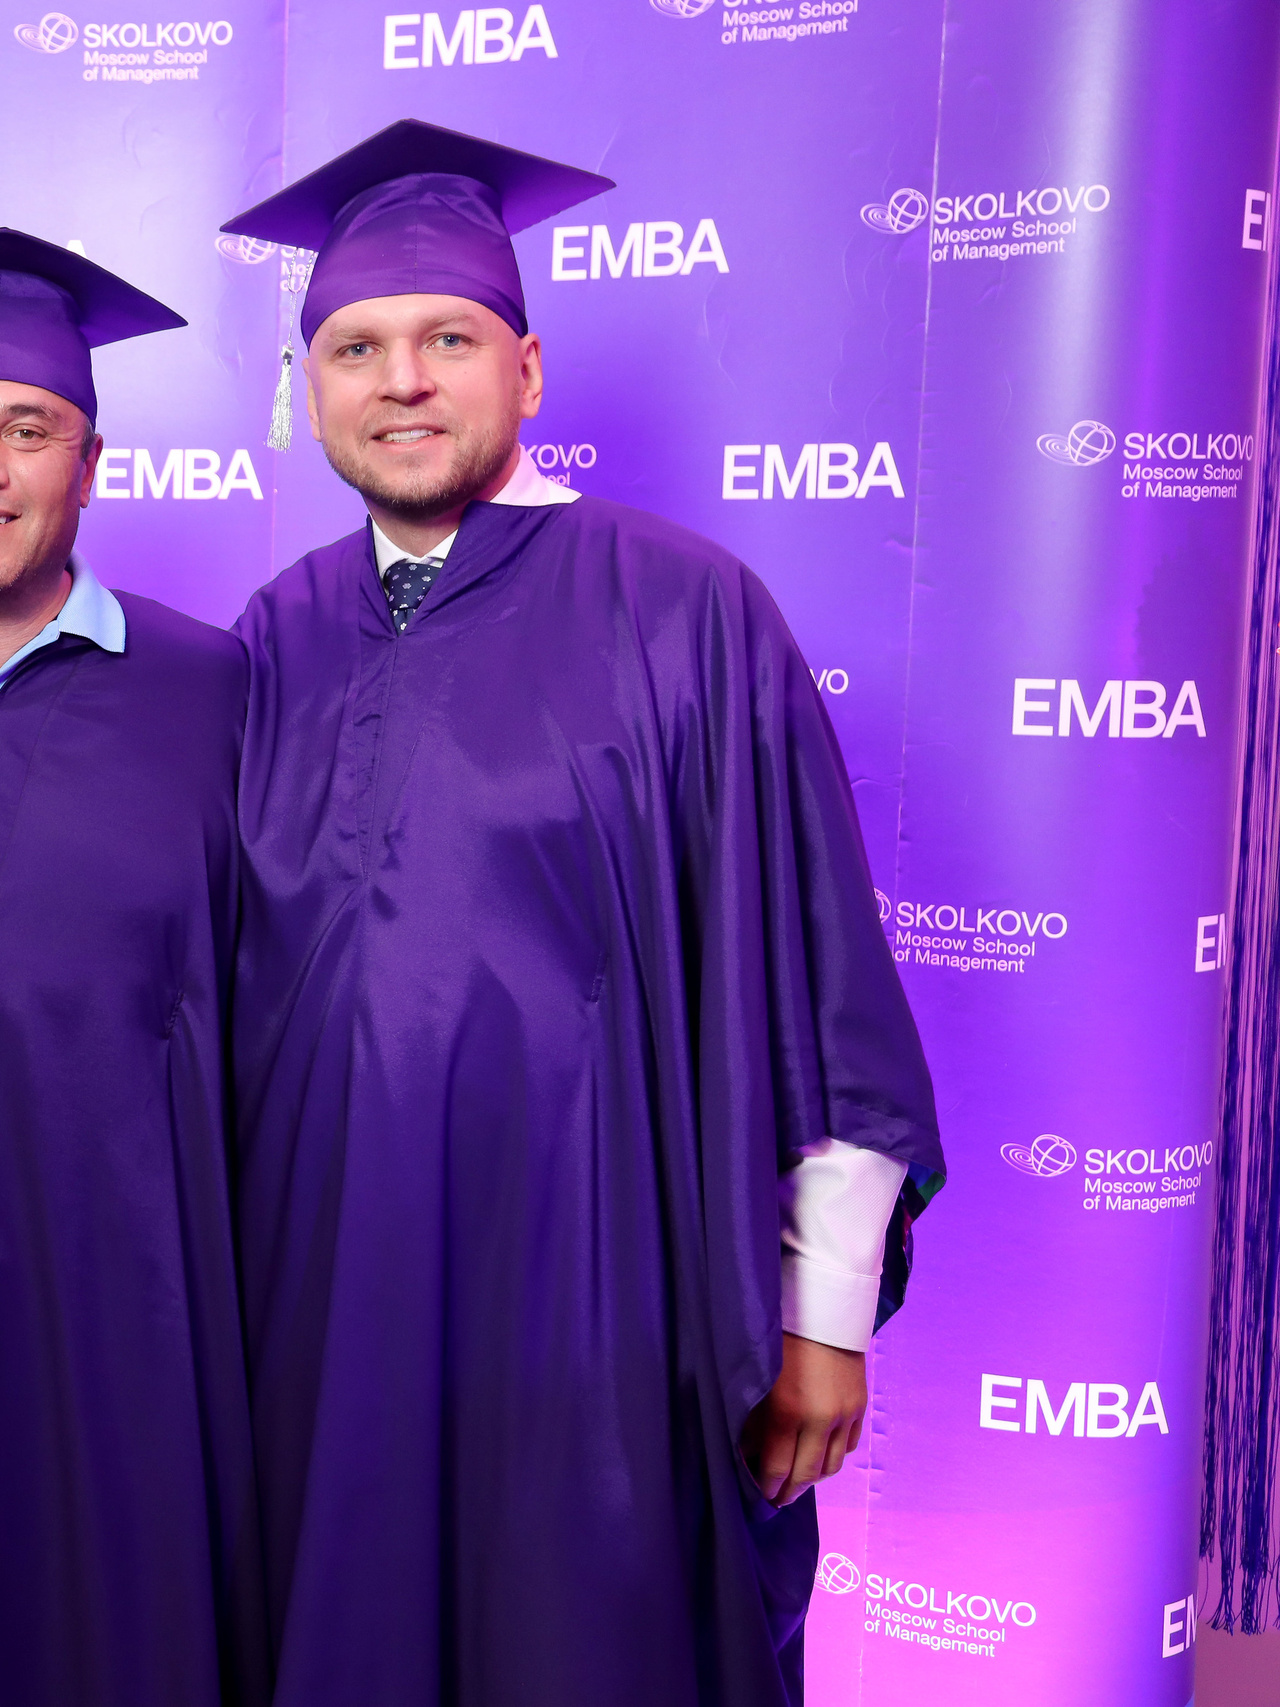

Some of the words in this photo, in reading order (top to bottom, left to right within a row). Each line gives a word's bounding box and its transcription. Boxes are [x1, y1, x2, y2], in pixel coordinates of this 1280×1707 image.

[723, 9, 794, 27] Moscow
[799, 0, 859, 19] School
[84, 21, 233, 47] SKOLKOVO
[384, 5, 558, 69] EMBA
[721, 27, 738, 44] of
[742, 16, 848, 42] Management
[84, 51, 149, 65] Moscow
[154, 49, 207, 64] School
[83, 67, 98, 81] of
[102, 66, 199, 84] Management
[933, 185, 1110, 224] SKOLKOVO
[933, 226, 1006, 245] Moscow
[1012, 218, 1076, 238] School
[551, 218, 730, 281] EMBA
[932, 243, 948, 262] of
[953, 238, 1064, 261] Management
[1124, 433, 1253, 460] SKOLKOVO
[95, 448, 263, 500] EMBA
[541, 471, 570, 487] ool
[722, 442, 904, 499] EMBA
[1124, 464, 1198, 479] Moscow
[1203, 464, 1242, 480] School
[1122, 482, 1140, 497] of
[1146, 482, 1237, 501] Management
[1012, 678, 1206, 738] EMBA
[896, 902, 1067, 938] SKOLKOVO
[896, 930, 966, 950] Moscow
[973, 937, 1035, 956] School
[895, 948, 910, 962] of
[916, 949, 1024, 973] Management
[1085, 1141, 1213, 1174] SKOLKOVO
[1085, 1178, 1156, 1193] Moscow
[1161, 1173, 1201, 1192] School
[1083, 1195, 1100, 1209] of
[1106, 1191, 1195, 1213] Management
[980, 1374, 1169, 1437] EMBA
[866, 1574, 1036, 1629] SKOLKOVO
[866, 1601, 937, 1629] Moscow
[943, 1619, 1005, 1642] School
[864, 1620, 880, 1633] of
[885, 1621, 995, 1658] Management
